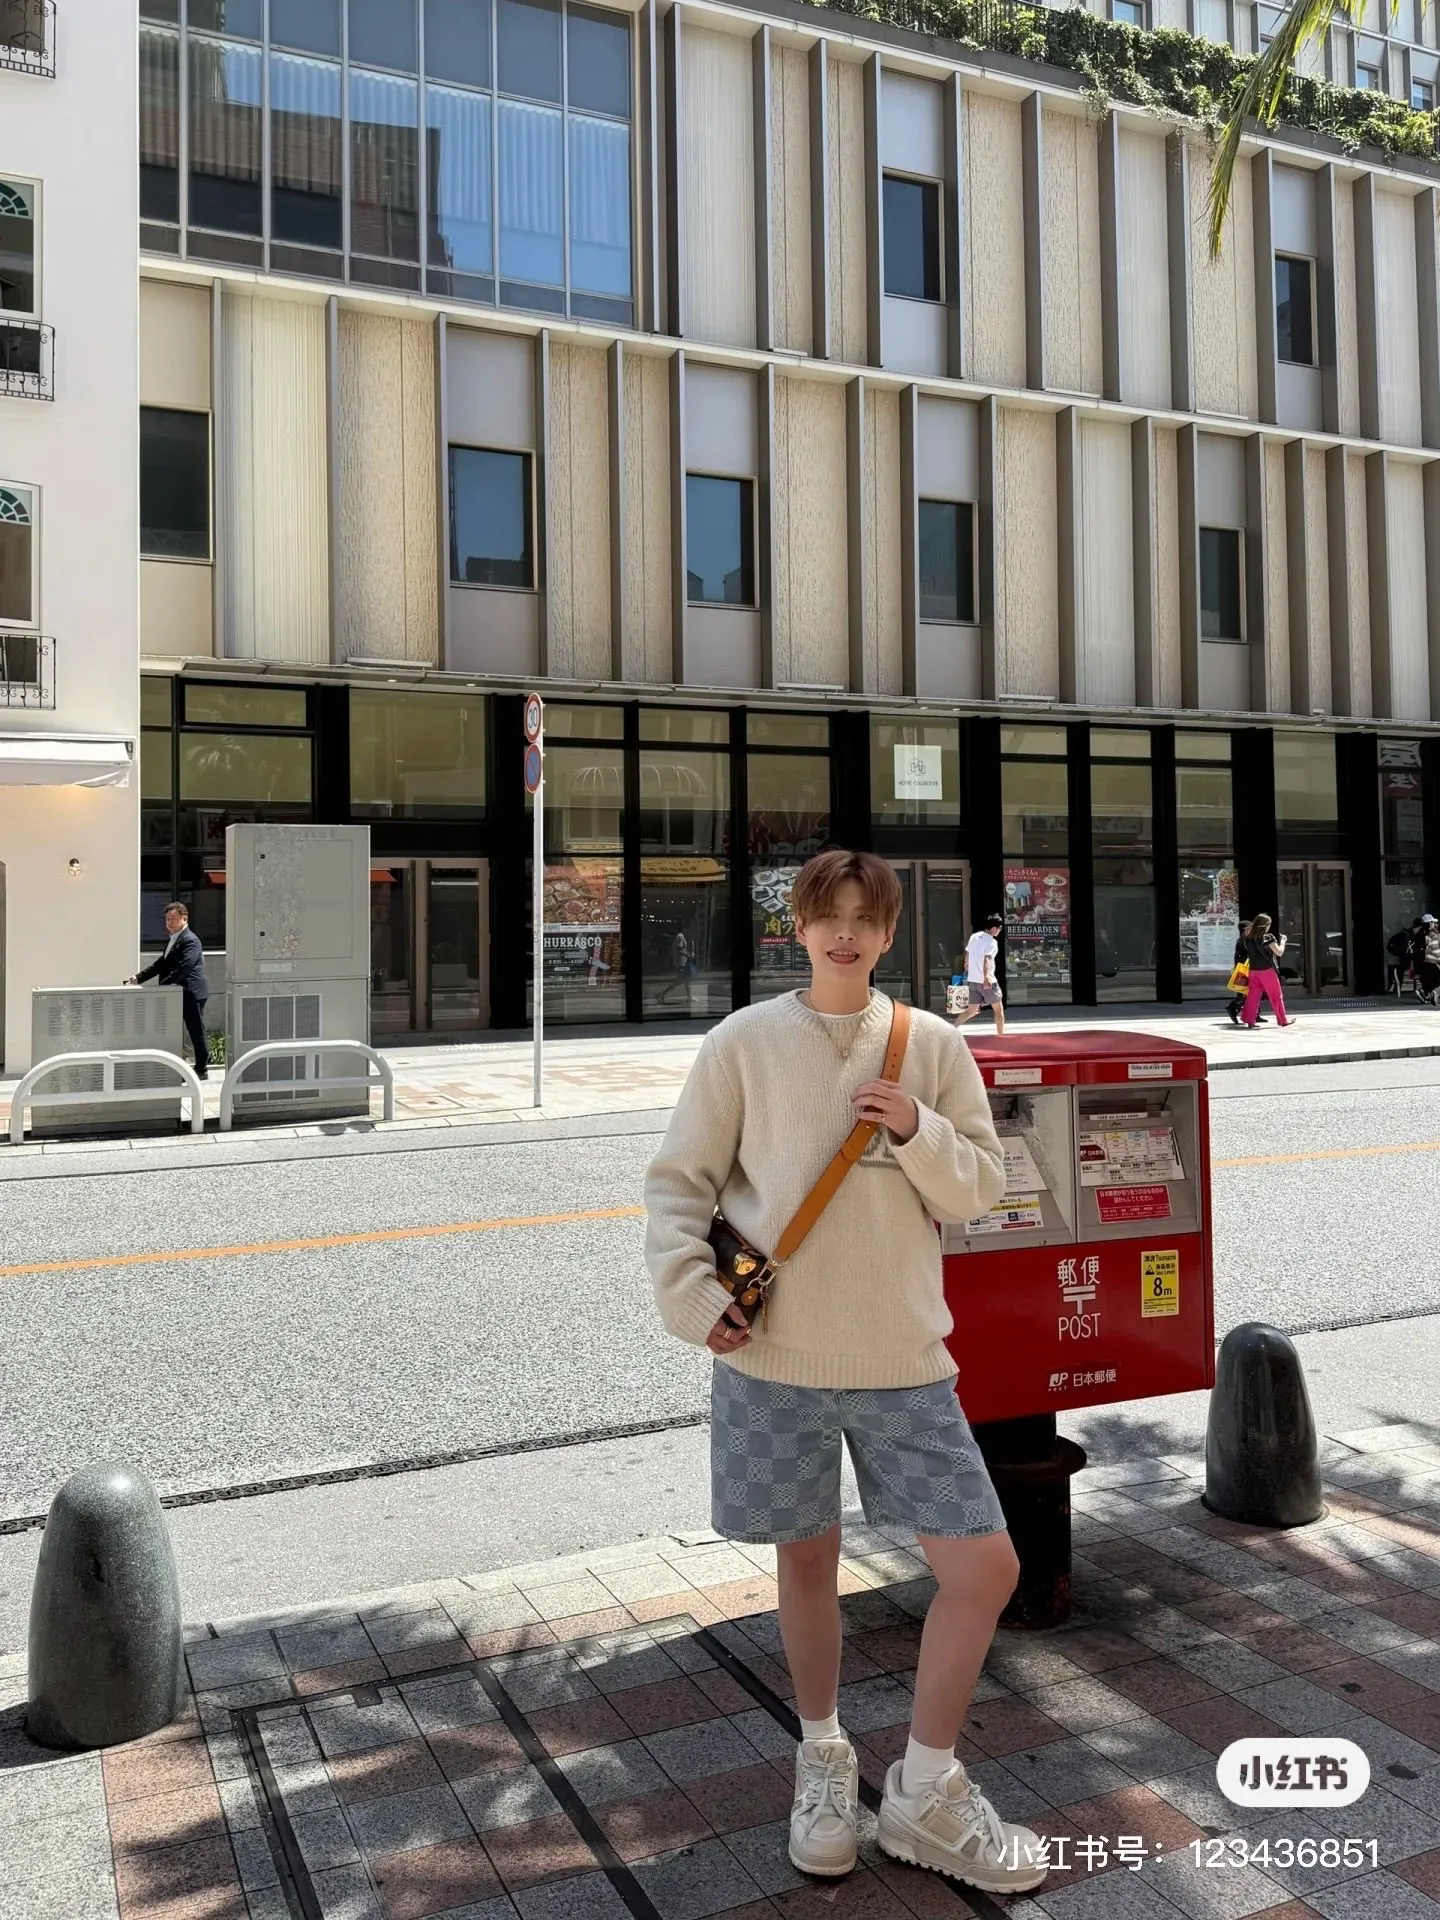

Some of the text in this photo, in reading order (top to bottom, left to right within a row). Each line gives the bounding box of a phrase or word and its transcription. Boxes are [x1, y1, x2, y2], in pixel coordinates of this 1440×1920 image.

[528, 706, 538, 729] 30
[1007, 925, 1060, 934] BEERGARDEN
[543, 936, 603, 949] HURRASCO
[1155, 1254, 1177, 1262] Tsunami
[1057, 1255, 1101, 1288] 郵便
[1058, 1312, 1102, 1342] POST
[1073, 1368, 1117, 1388] 日本郵便
